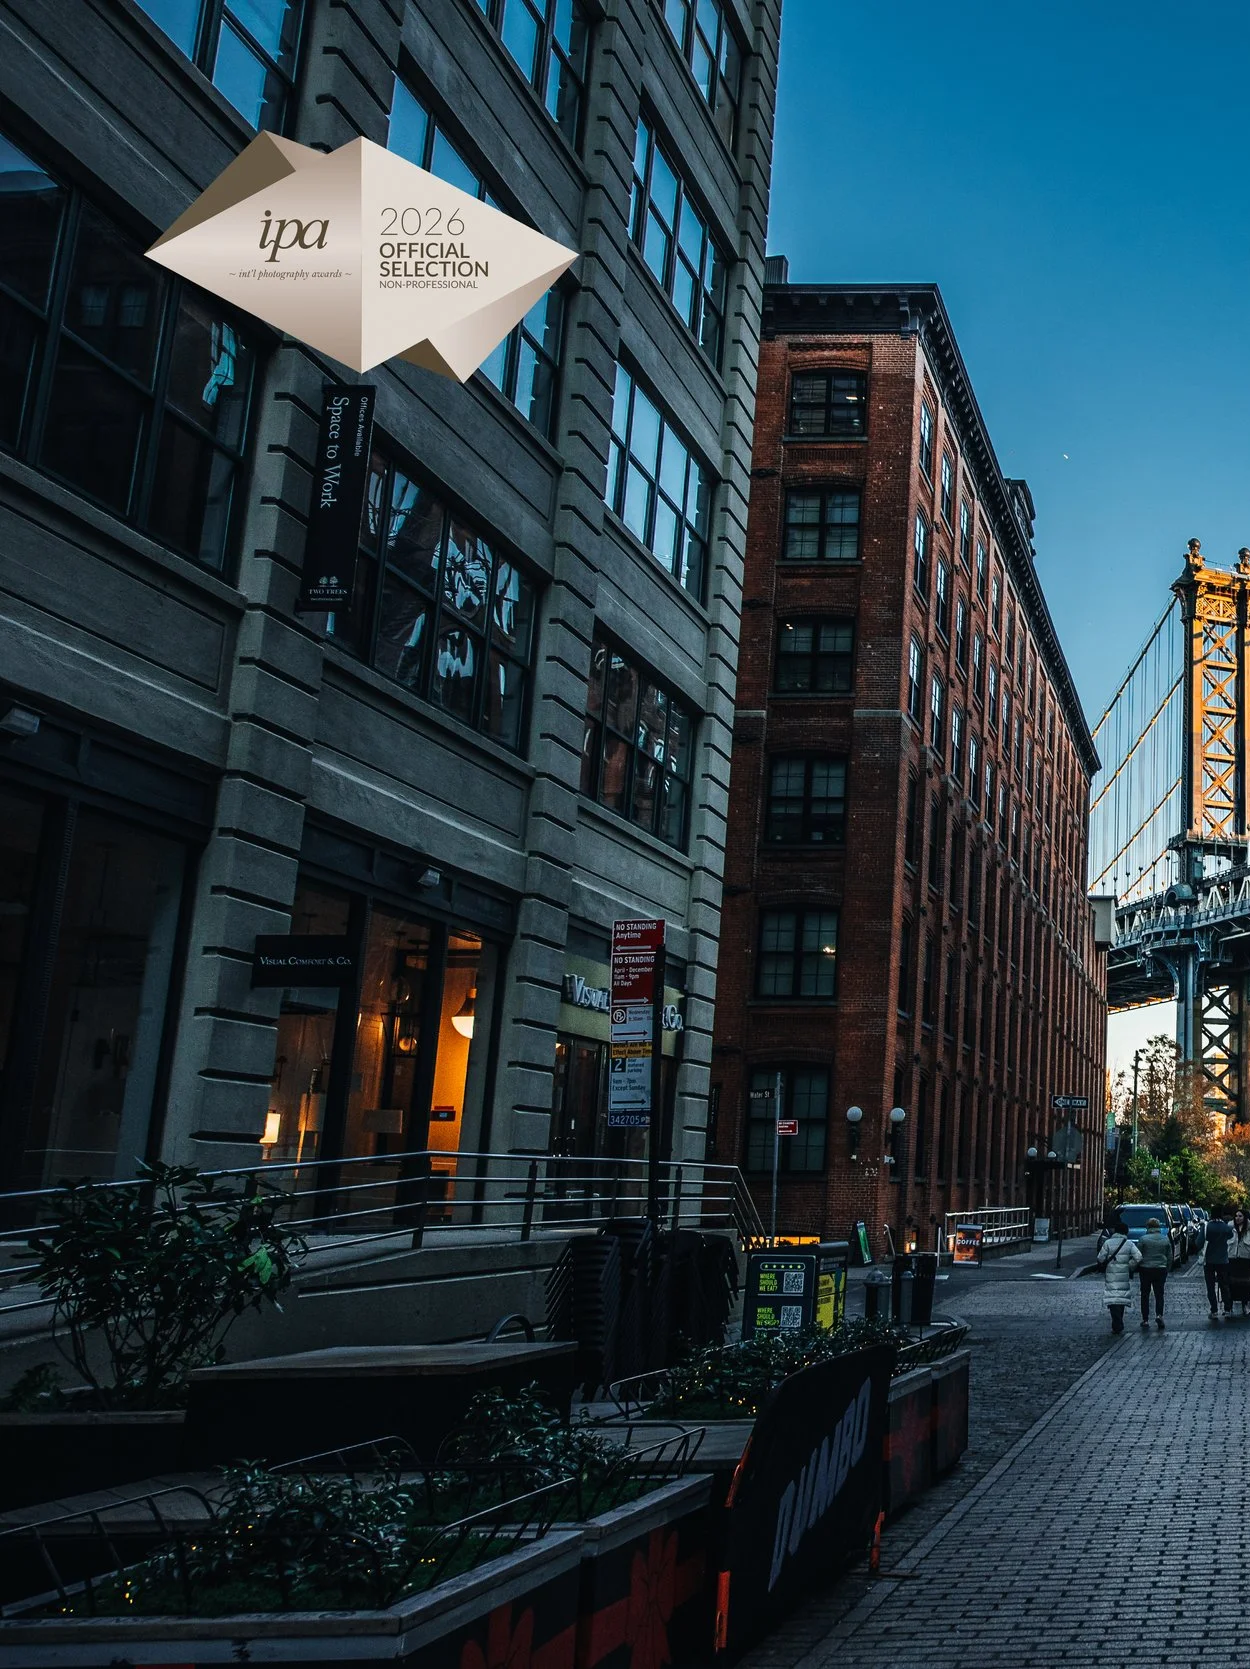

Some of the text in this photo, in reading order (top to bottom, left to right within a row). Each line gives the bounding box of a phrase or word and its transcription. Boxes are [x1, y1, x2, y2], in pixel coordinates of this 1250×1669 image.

[353, 396, 369, 457] Offices Available
[320, 396, 350, 509] Space to Work
[615, 922, 657, 931] NO STANDING
[615, 932, 642, 940] Anytime
[327, 957, 335, 966] &
[614, 955, 655, 964] NO STANDING
[614, 1058, 623, 1072] 2
[610, 1115, 640, 1125] 342705
[956, 1238, 980, 1247] COFFEE
[767, 1374, 872, 1593] DUMBO
